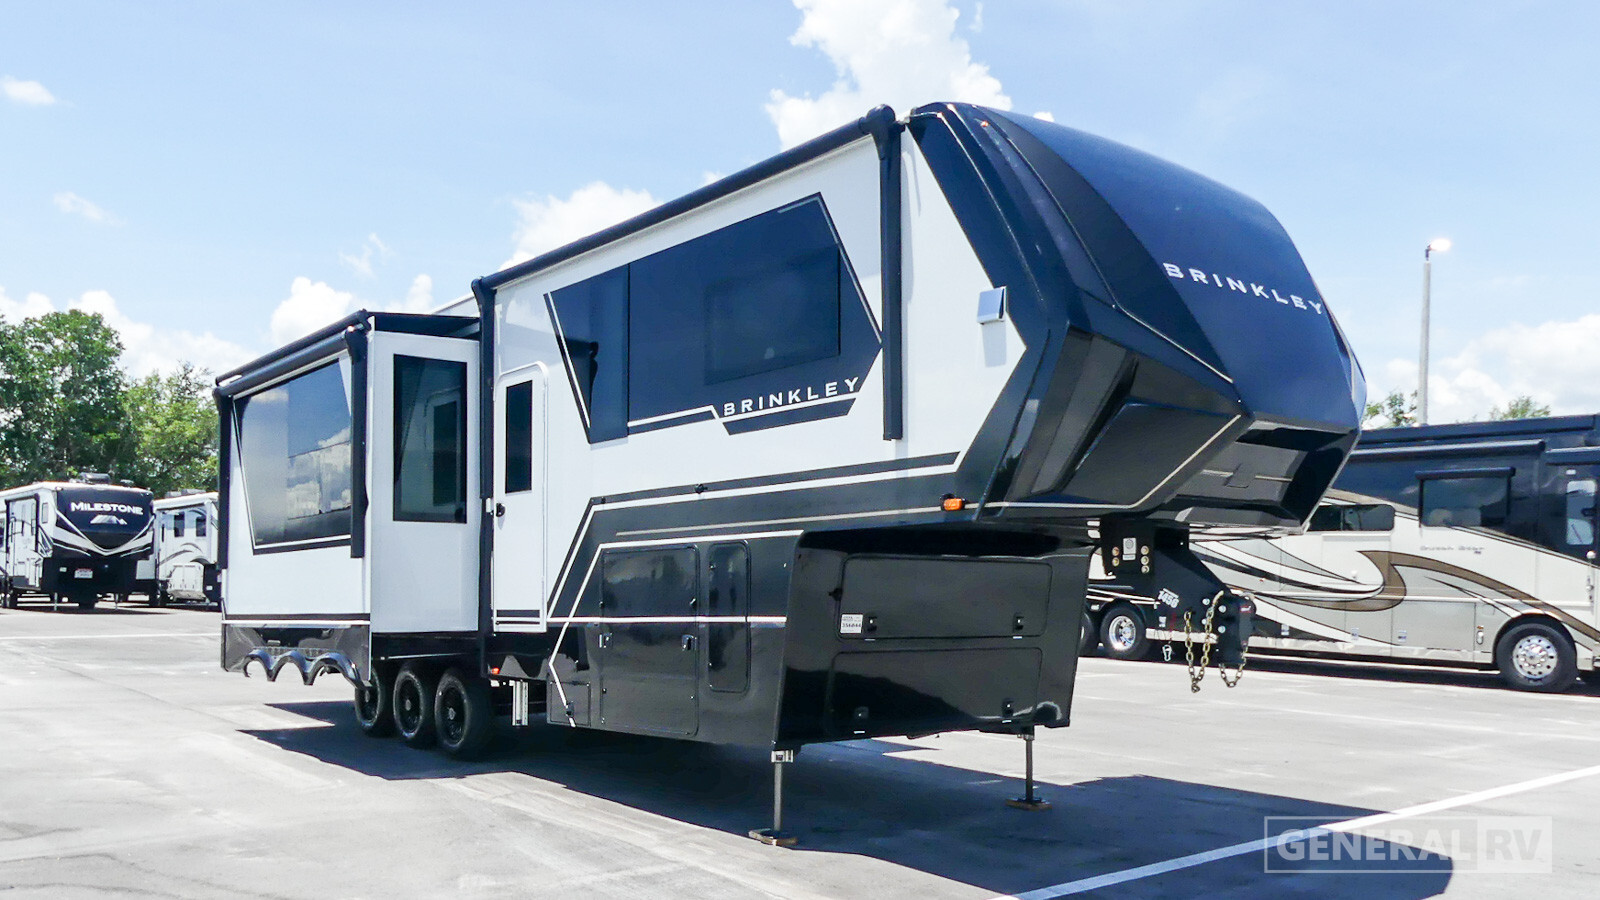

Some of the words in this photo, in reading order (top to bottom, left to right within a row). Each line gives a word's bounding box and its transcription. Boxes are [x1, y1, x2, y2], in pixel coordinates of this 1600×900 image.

[1163, 262, 1322, 315] BRINKLEY
[723, 376, 859, 416] BRINKLEY
[70, 501, 144, 515] MILESTONE
